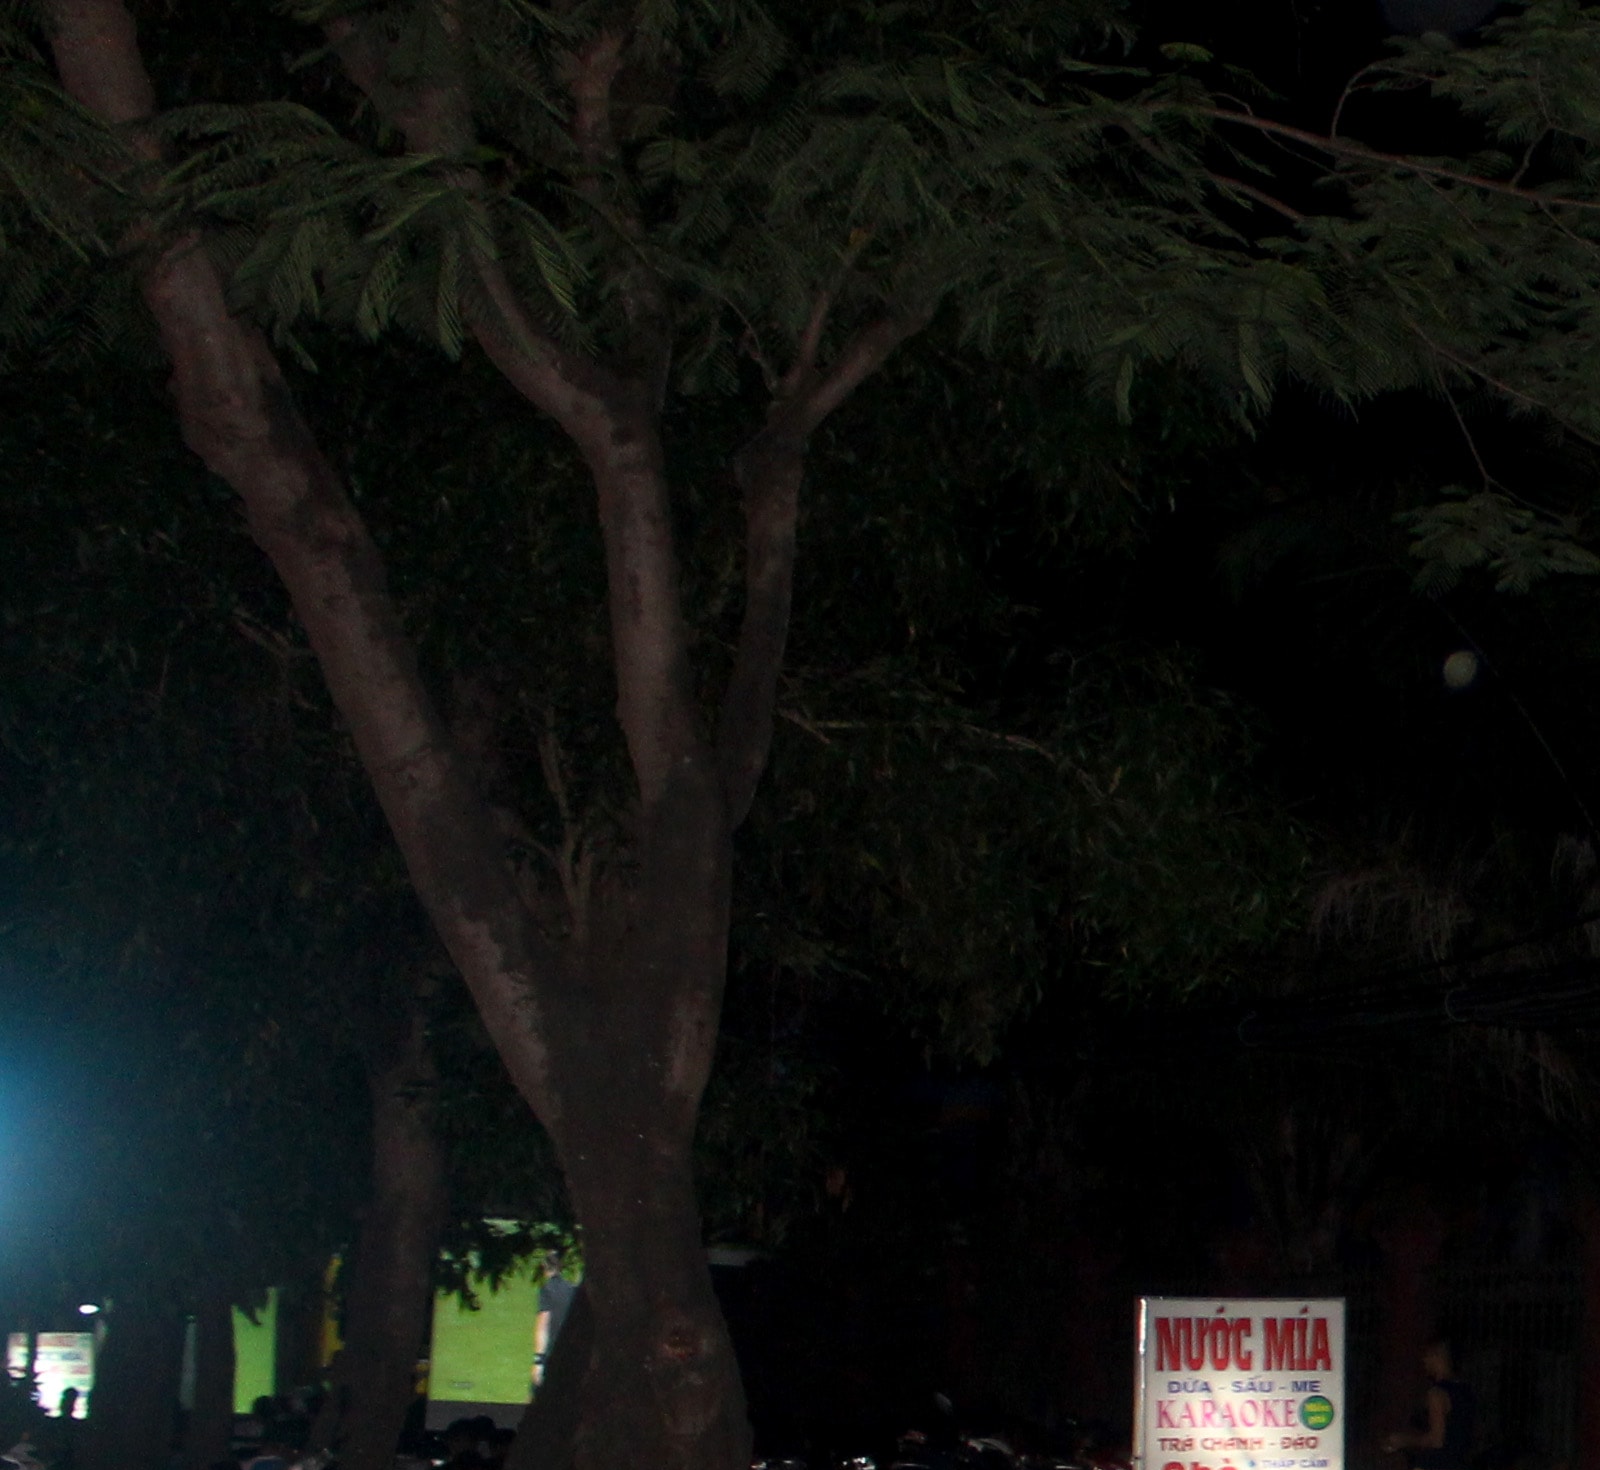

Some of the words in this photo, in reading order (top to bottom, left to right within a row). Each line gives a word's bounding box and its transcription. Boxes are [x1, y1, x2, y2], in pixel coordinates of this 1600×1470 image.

[1155, 1307, 1253, 1371] NƯỚC
[1262, 1306, 1332, 1371] MÍA
[1291, 1380, 1321, 1393] ME
[1156, 1399, 1298, 1429] KARAOKE
[1201, 1437, 1264, 1451] CHANH
